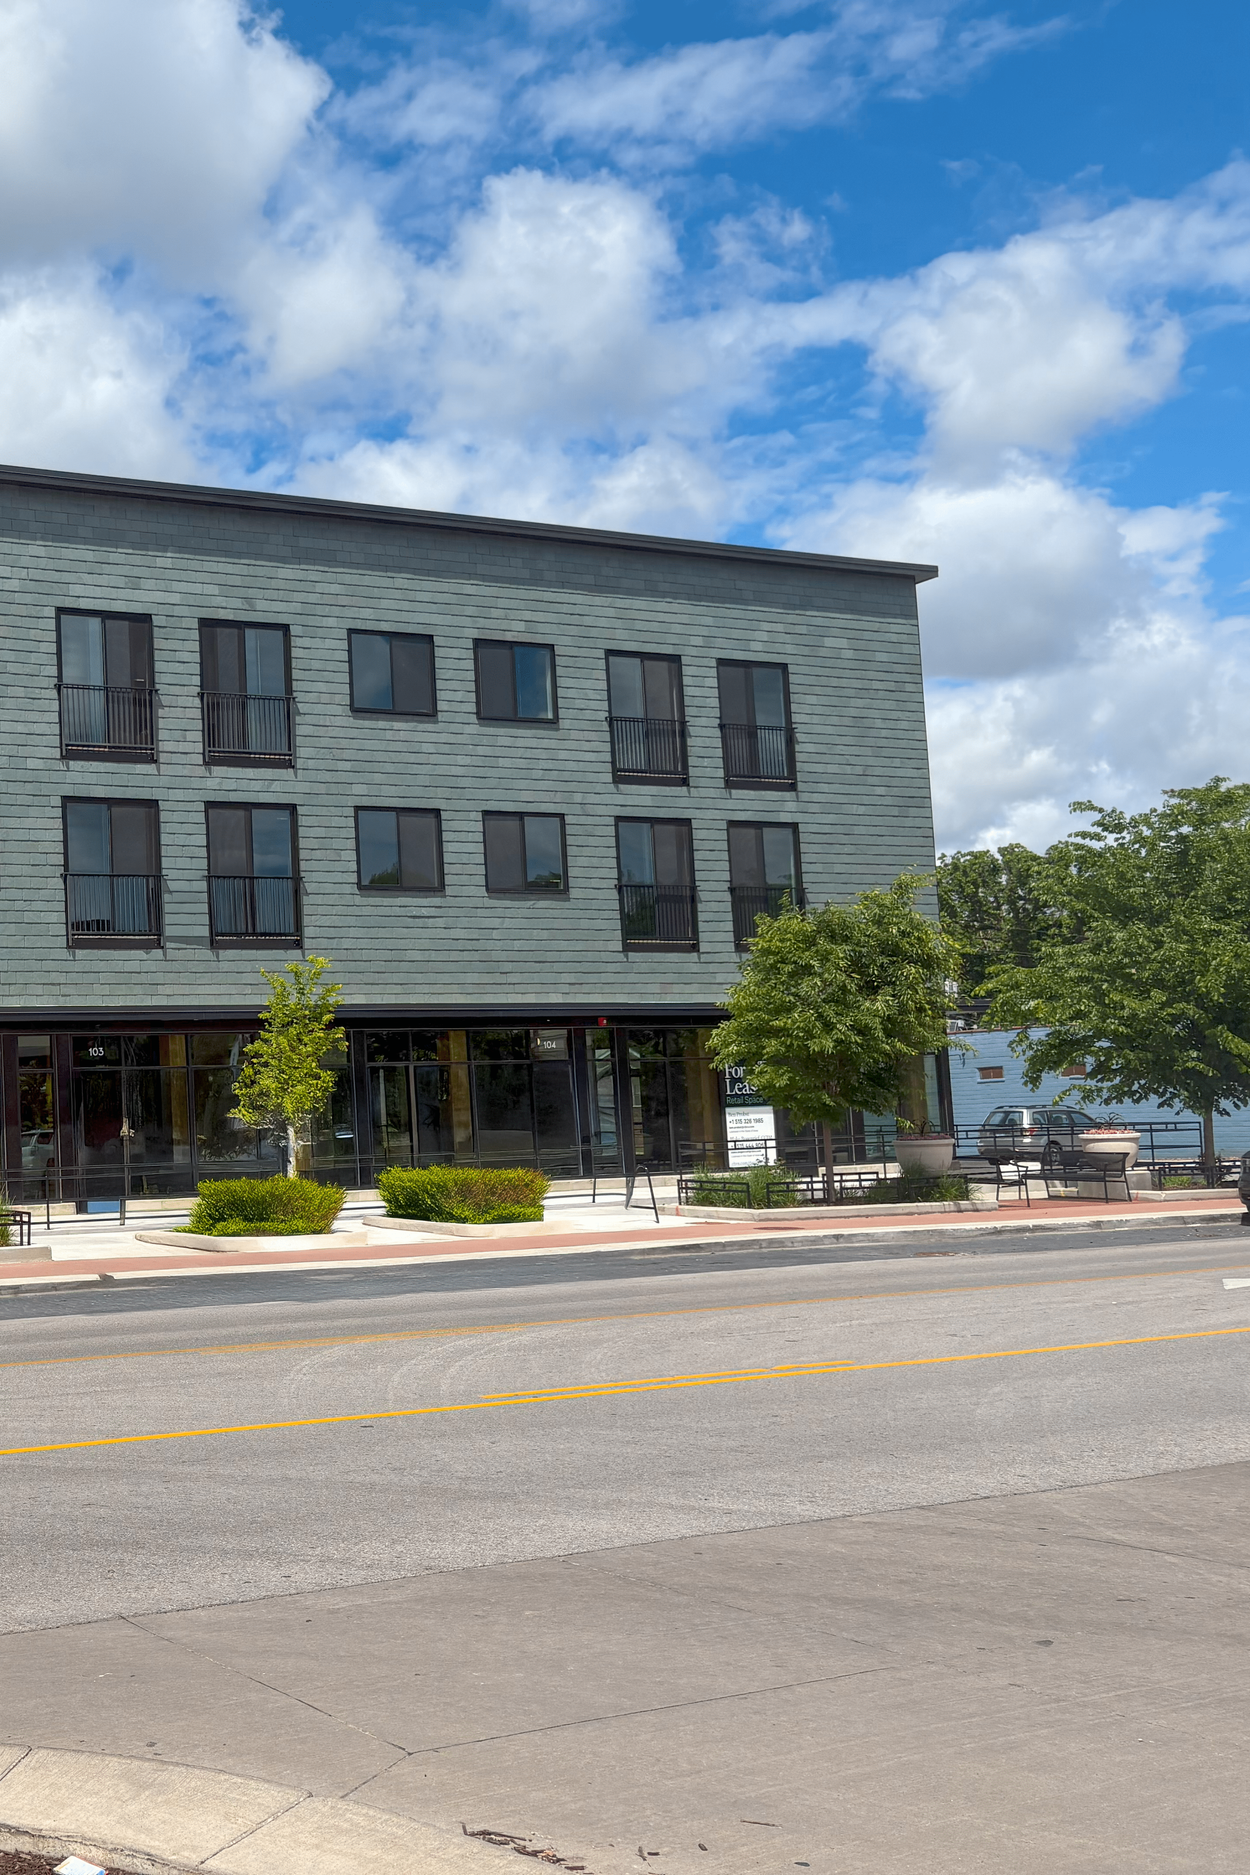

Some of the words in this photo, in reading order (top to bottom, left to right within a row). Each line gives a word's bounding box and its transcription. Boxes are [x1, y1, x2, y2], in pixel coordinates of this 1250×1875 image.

[543, 1040, 557, 1049] 104
[88, 1047, 105, 1057] 103
[725, 1063, 746, 1078] For
[725, 1079, 758, 1094] Leas
[744, 1096, 763, 1105] Space
